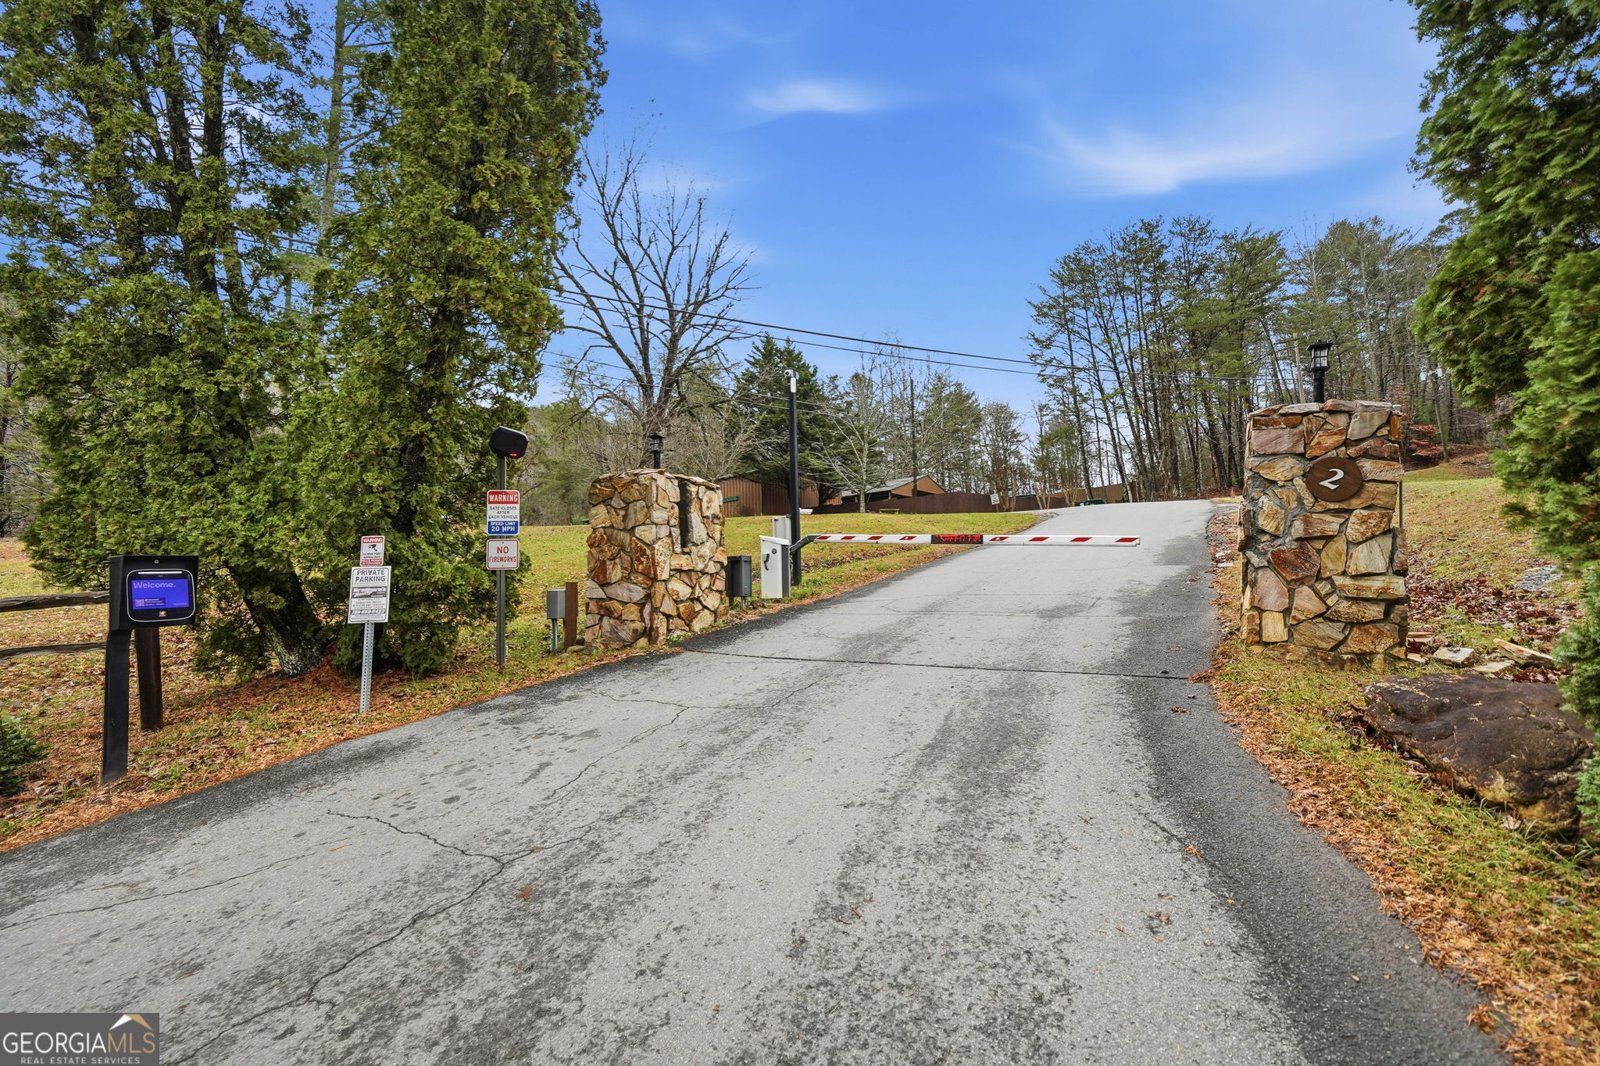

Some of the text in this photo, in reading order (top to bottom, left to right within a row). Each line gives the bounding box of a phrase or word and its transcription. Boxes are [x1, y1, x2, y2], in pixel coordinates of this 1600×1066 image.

[1319, 468, 1345, 490] 2
[489, 494, 519, 502] WARNING
[496, 546, 510, 554] NO
